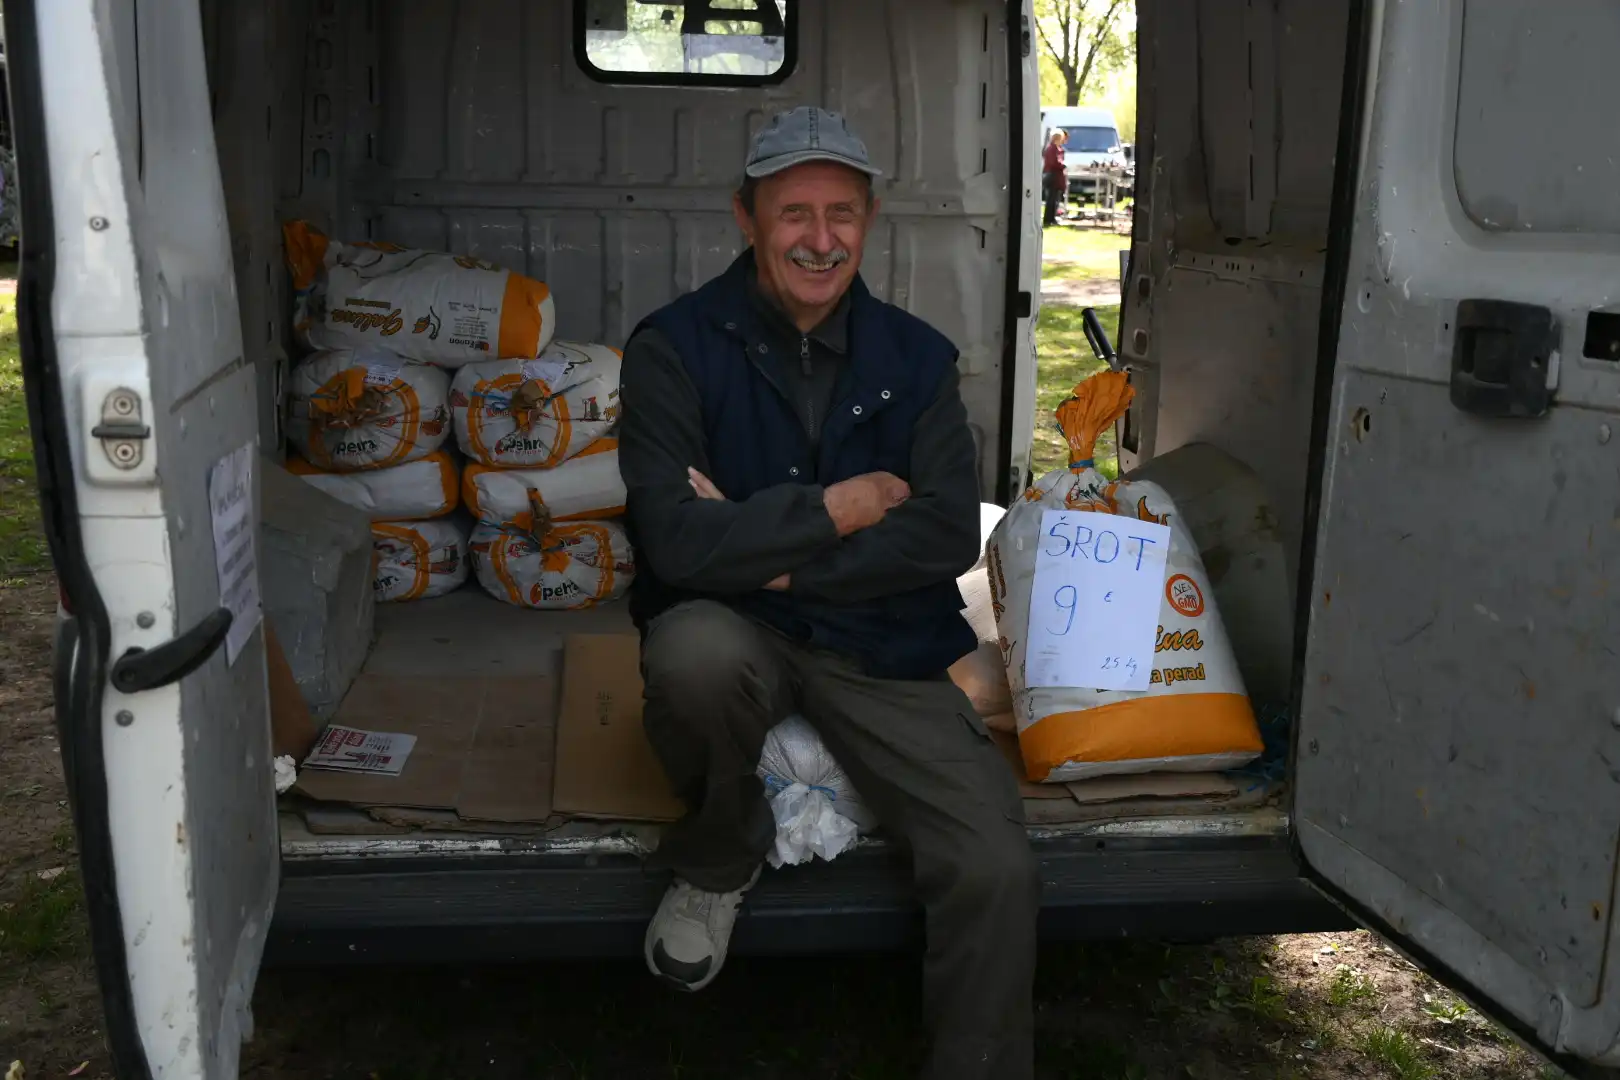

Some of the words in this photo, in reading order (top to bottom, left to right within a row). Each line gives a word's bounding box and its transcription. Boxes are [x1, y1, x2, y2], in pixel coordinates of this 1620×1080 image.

[1046, 516, 1156, 571] ŠROT
[1046, 585, 1077, 636] 9
[1101, 657, 1120, 670] 25
[1163, 663, 1206, 686] perad
